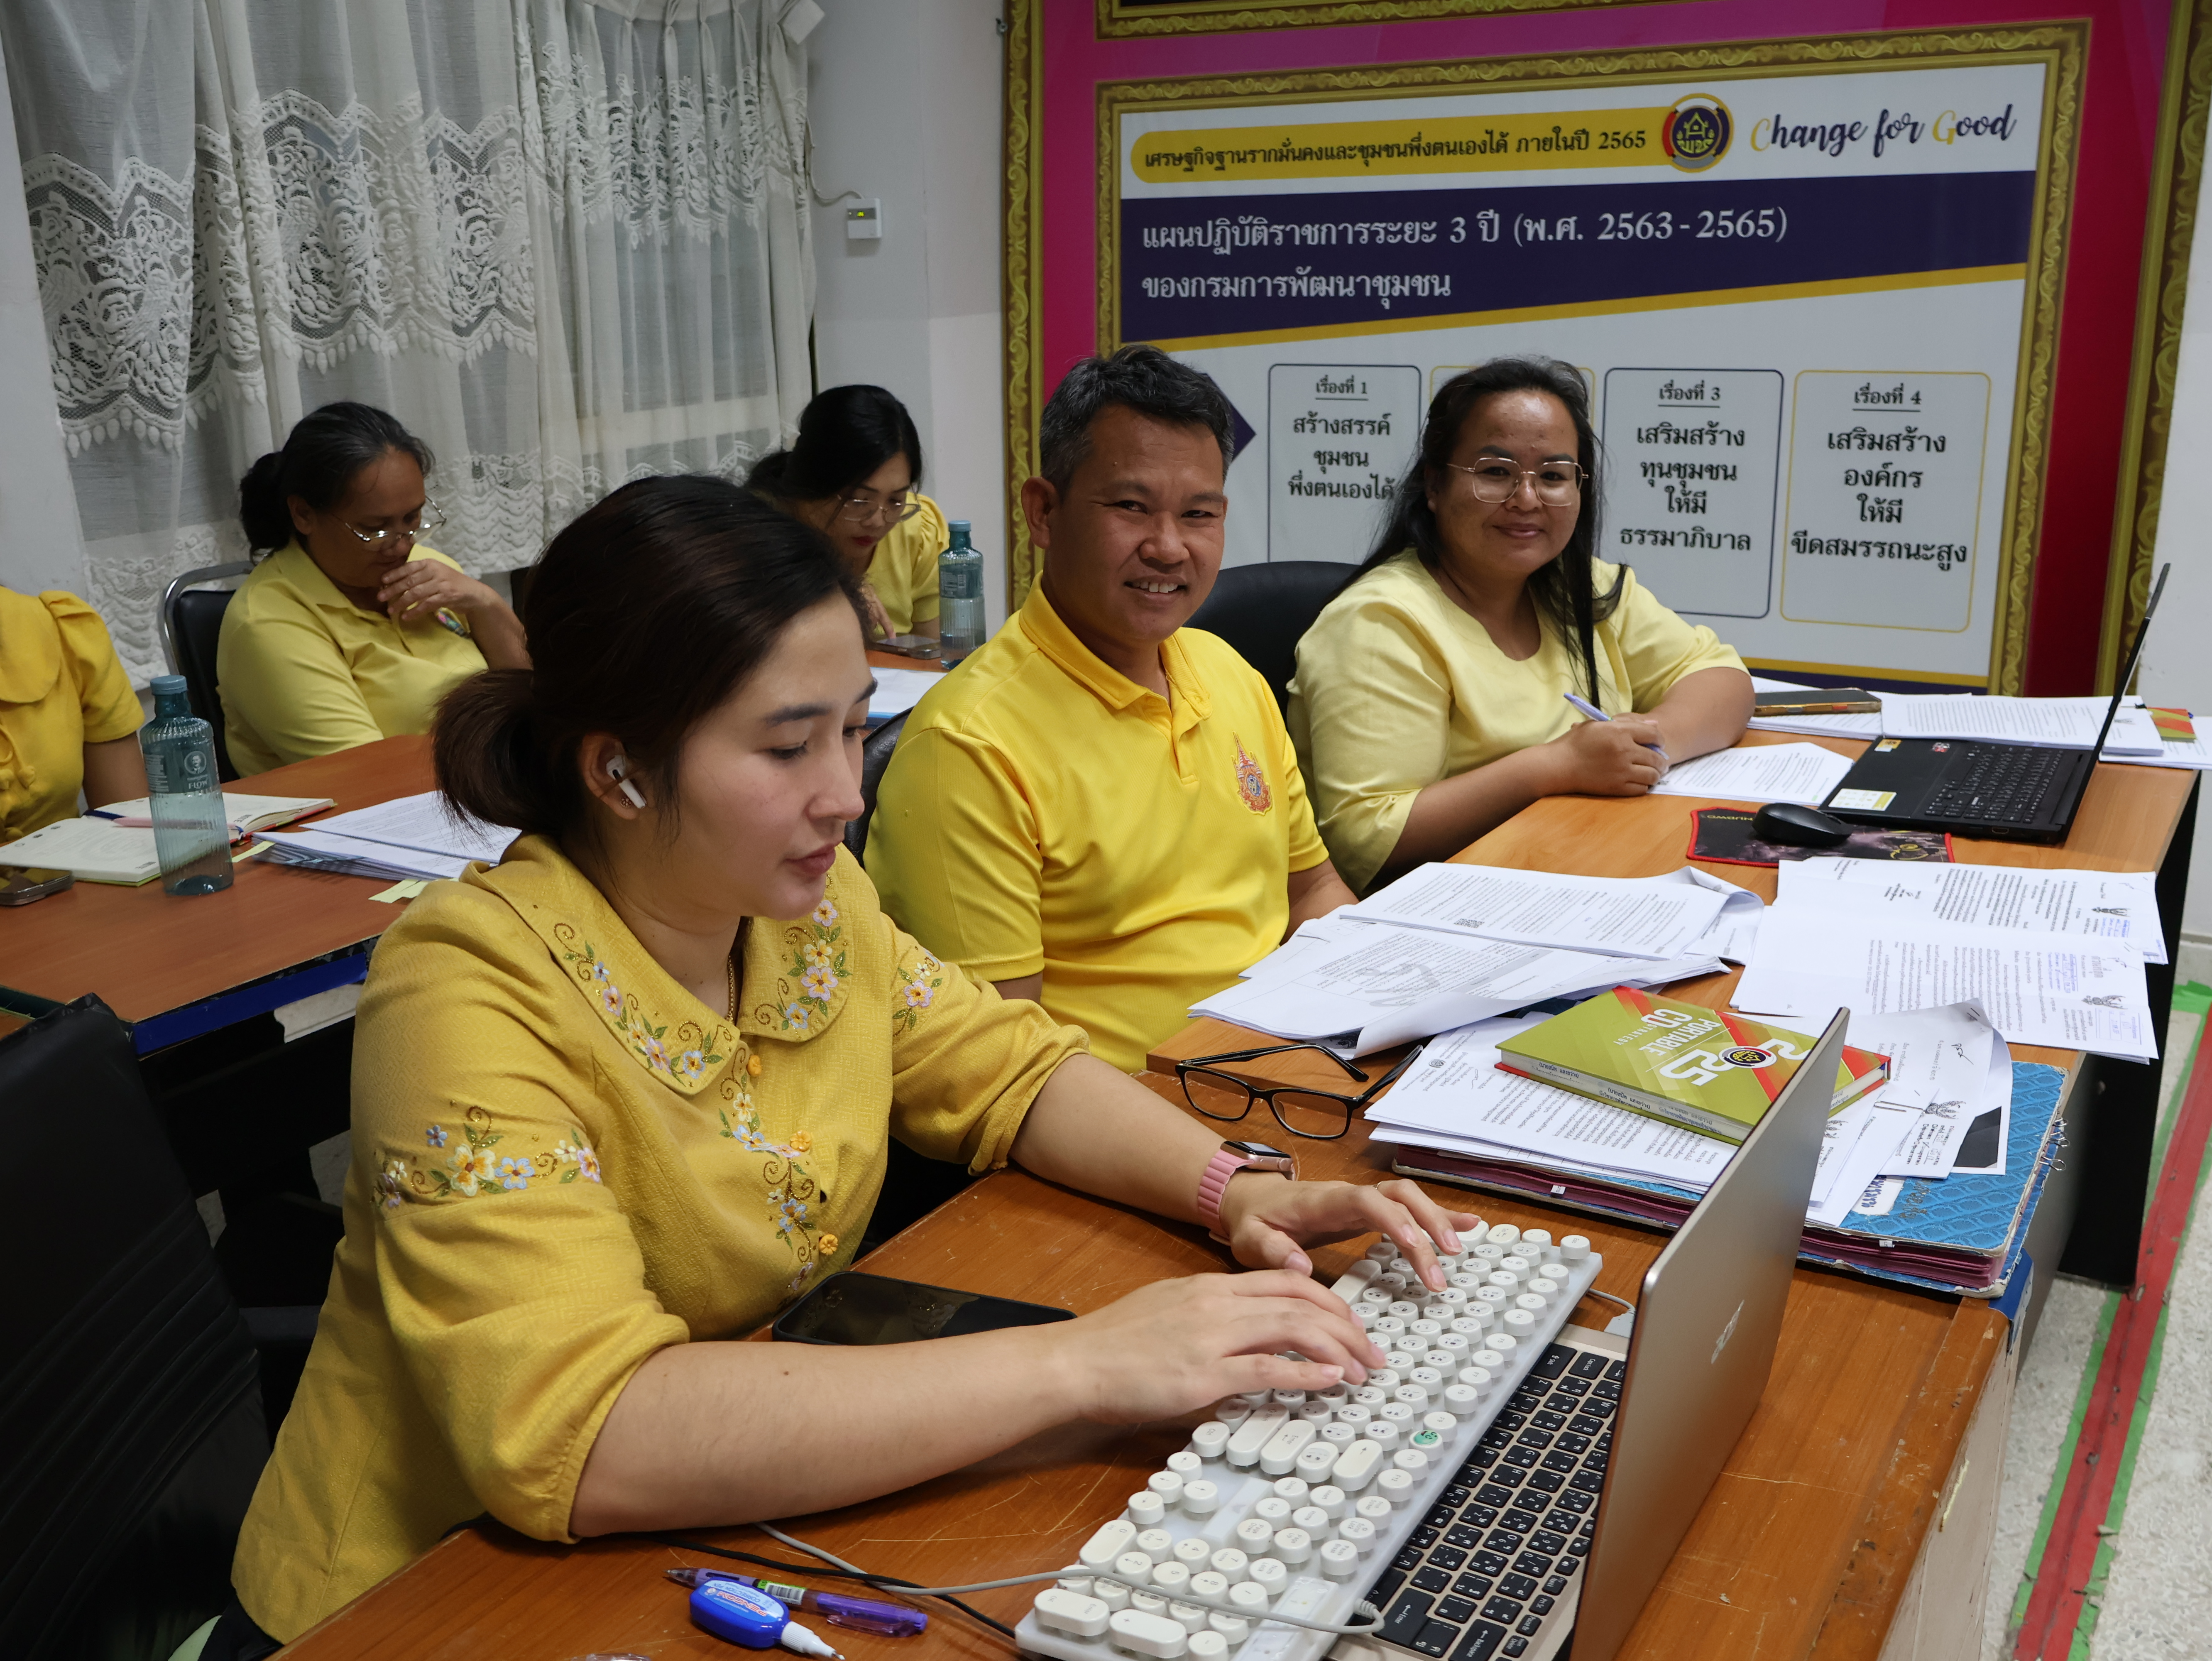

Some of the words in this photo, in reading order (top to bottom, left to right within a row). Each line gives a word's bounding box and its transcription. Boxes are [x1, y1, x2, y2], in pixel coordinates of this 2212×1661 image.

[1750, 114, 1868, 157] Change
[1873, 109, 1925, 158] for
[1932, 103, 2017, 145] Good
[1145, 130, 1509, 171] เศรษฐกิจฐานรากมั่นคงและชุมชนพึ่งตนเองได้
[1516, 126, 1590, 154] ภายในปี
[1598, 130, 1647, 151] 2565
[1143, 214, 1437, 255] แผนปฏิบัติราชการระยะ
[1449, 217, 1467, 243] 3
[1476, 208, 1500, 242] ปี
[1513, 213, 1584, 247] (พ.ศ.
[1142, 265, 1452, 310] ของกรมการพัฒนาชุมชน
[1316, 375, 1355, 394] เรื่องที่
[1361, 382, 1368, 394] 1
[1659, 380, 1705, 401] เรื่องที่
[1711, 387, 1720, 401] 3
[1854, 383, 1904, 406] เรื่องที่
[1910, 391, 1922, 406] 4
[1293, 411, 1392, 436] สร้างสรรค์
[1637, 420, 1746, 447] เสริมสร้าง
[1828, 426, 1947, 453] เสริมสร้าง
[1313, 450, 1370, 474] ชุมชน
[1640, 459, 1737, 489] ทุนชุมชน
[1843, 462, 1924, 489] องค์กร
[1288, 470, 1396, 499] พึ่งตนเองได้
[1664, 485, 1707, 515] ให้มี
[1857, 493, 1904, 524] ให้มี
[1620, 526, 1752, 551] ธรรมาภิบาล
[1791, 530, 1968, 571] ขีดสมรรถนะสูง
[1640, 1009, 1693, 1029] CD
[1613, 1022, 1657, 1046] STRATEGY
[1638, 1019, 1719, 1056] PORTABLE
